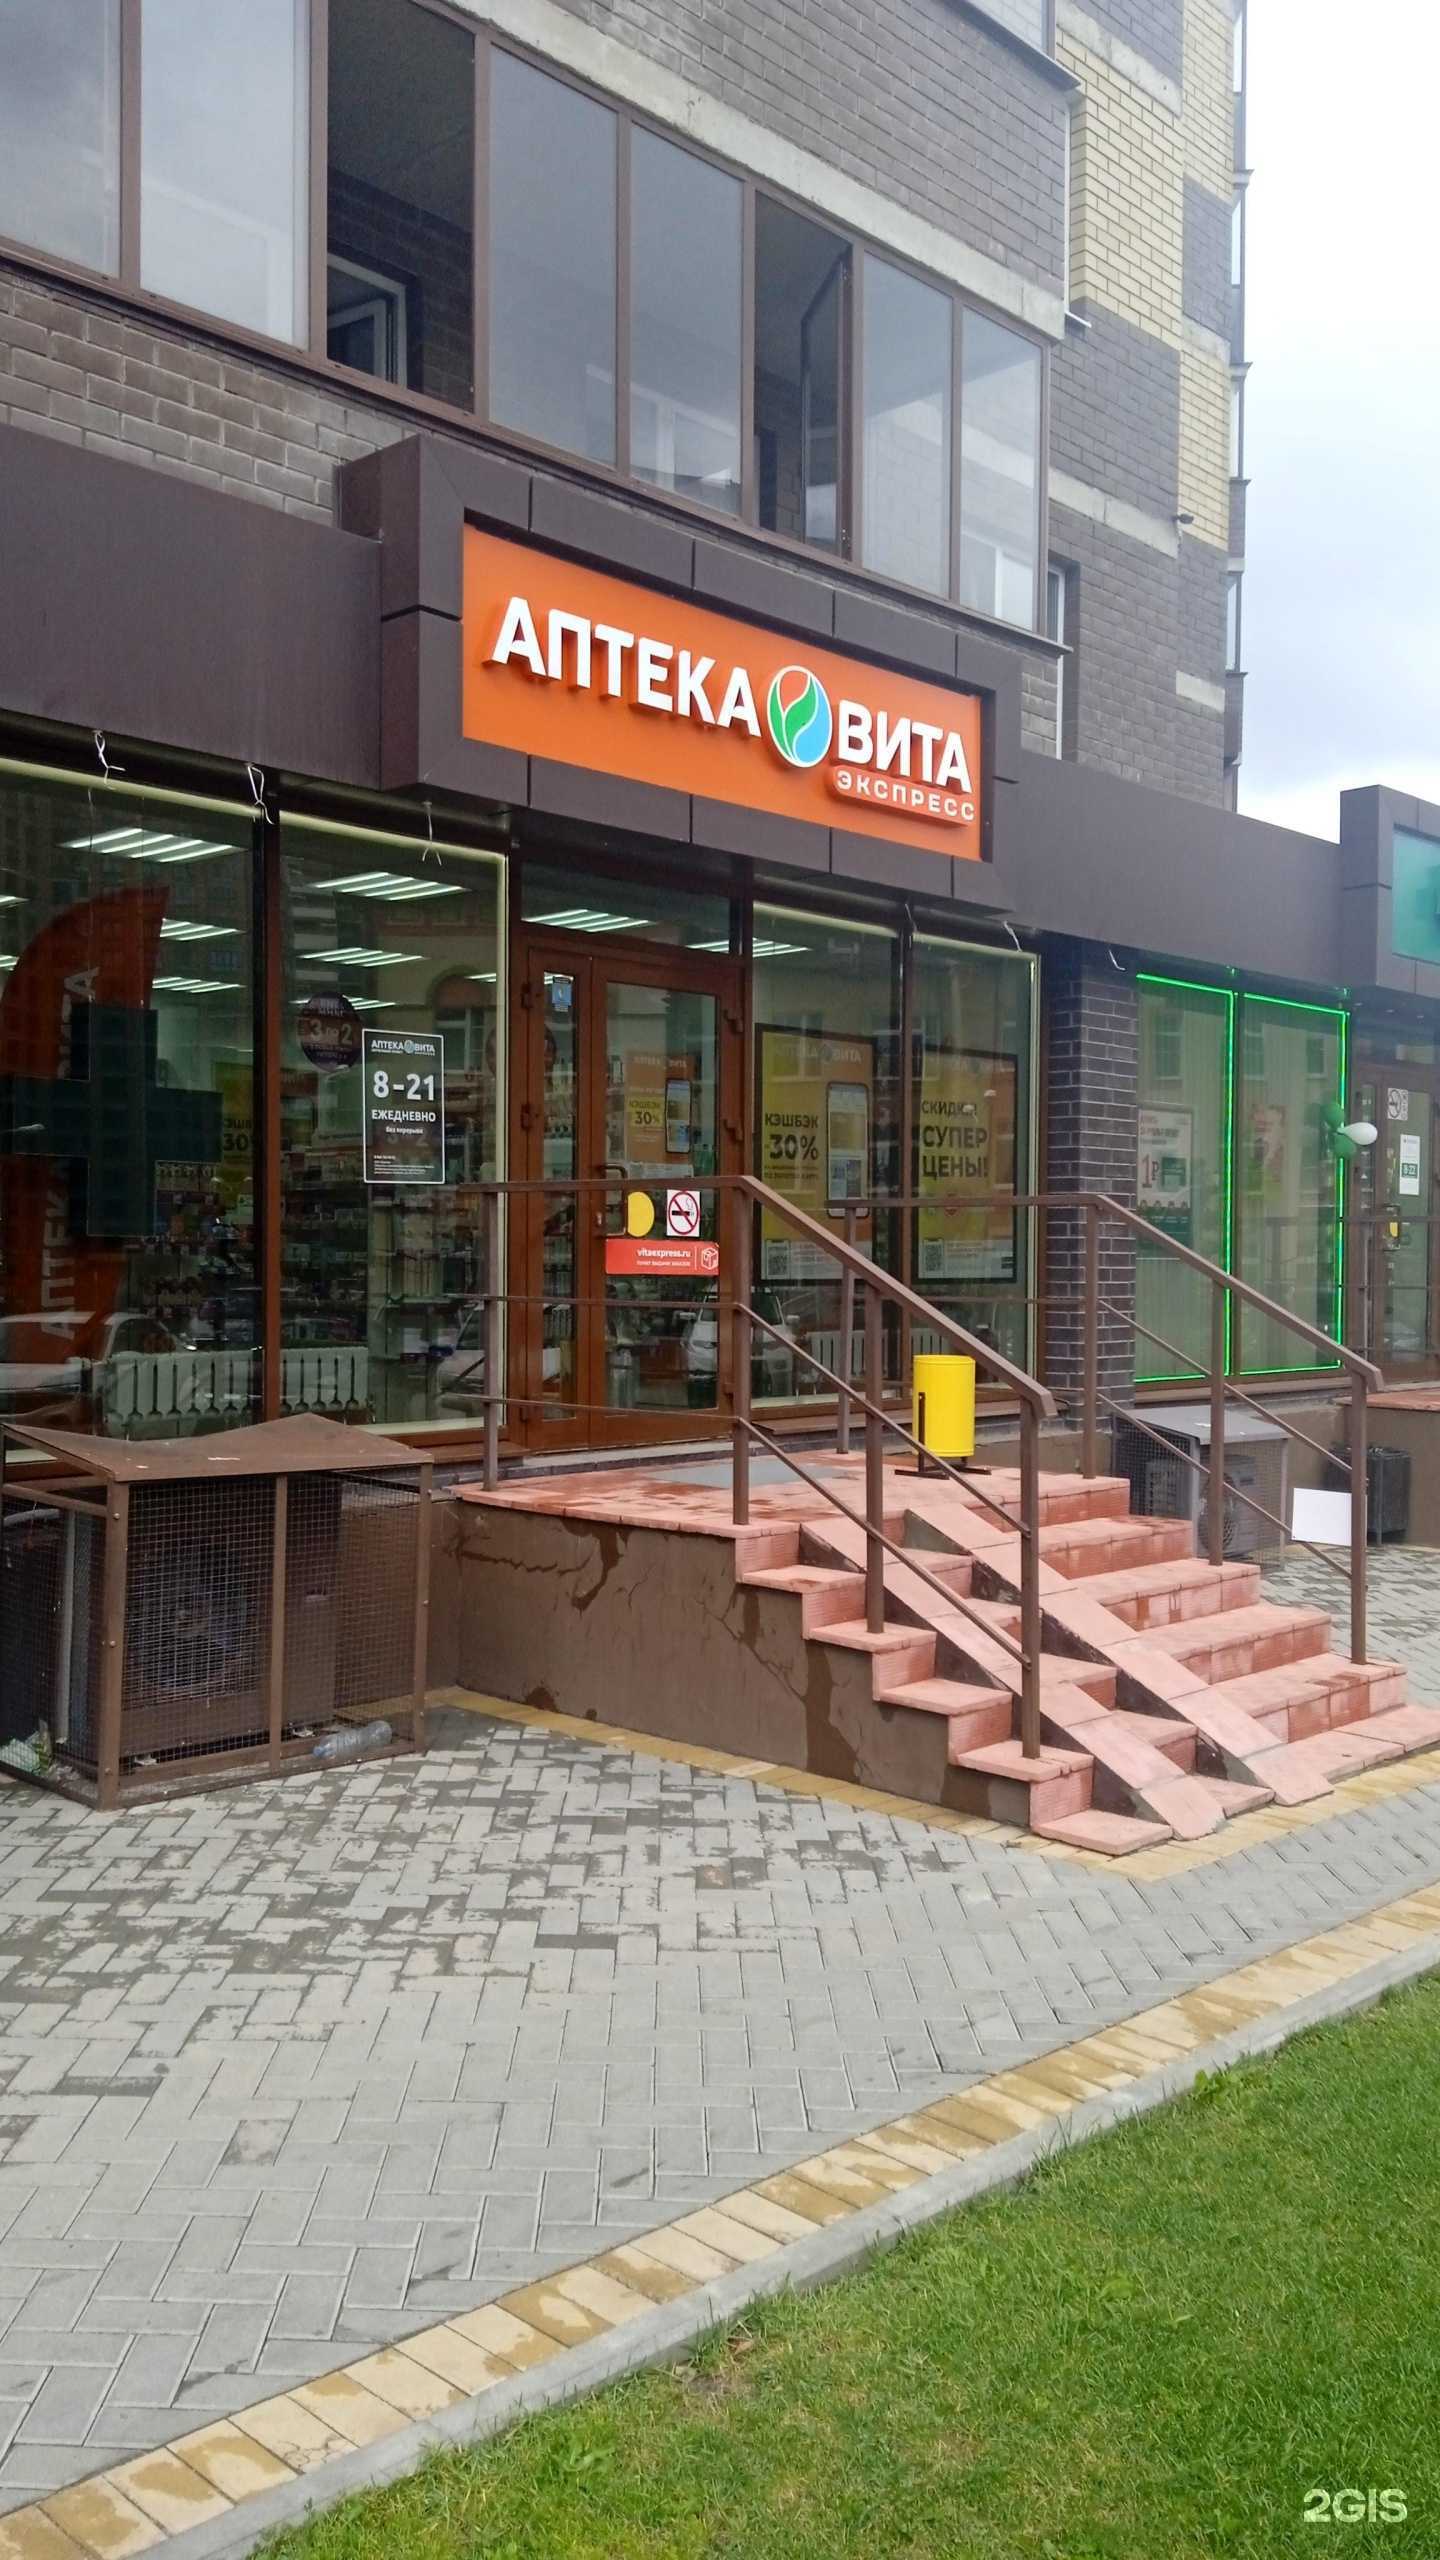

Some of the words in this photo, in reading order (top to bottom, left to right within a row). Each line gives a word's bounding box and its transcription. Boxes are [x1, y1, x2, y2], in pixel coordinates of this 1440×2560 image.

[491, 596, 762, 738] АПТЕКА
[837, 698, 972, 793] ВИТА
[836, 771, 975, 822] ЭКСПРЕСС
[371, 1039, 404, 1052] АПТЕКА
[414, 1043, 436, 1053] ВИТА
[371, 1109, 437, 1123] ЕЖЕДНЕВНО
[635, 1111, 660, 1125] 30%
[764, 1112, 819, 1128] КЭШБЭК
[922, 1125, 988, 1149] СУПЕР
[921, 1155, 989, 1181] ЦЕНЫ!
[636, 1247, 691, 1259] vitaexpress.ru
